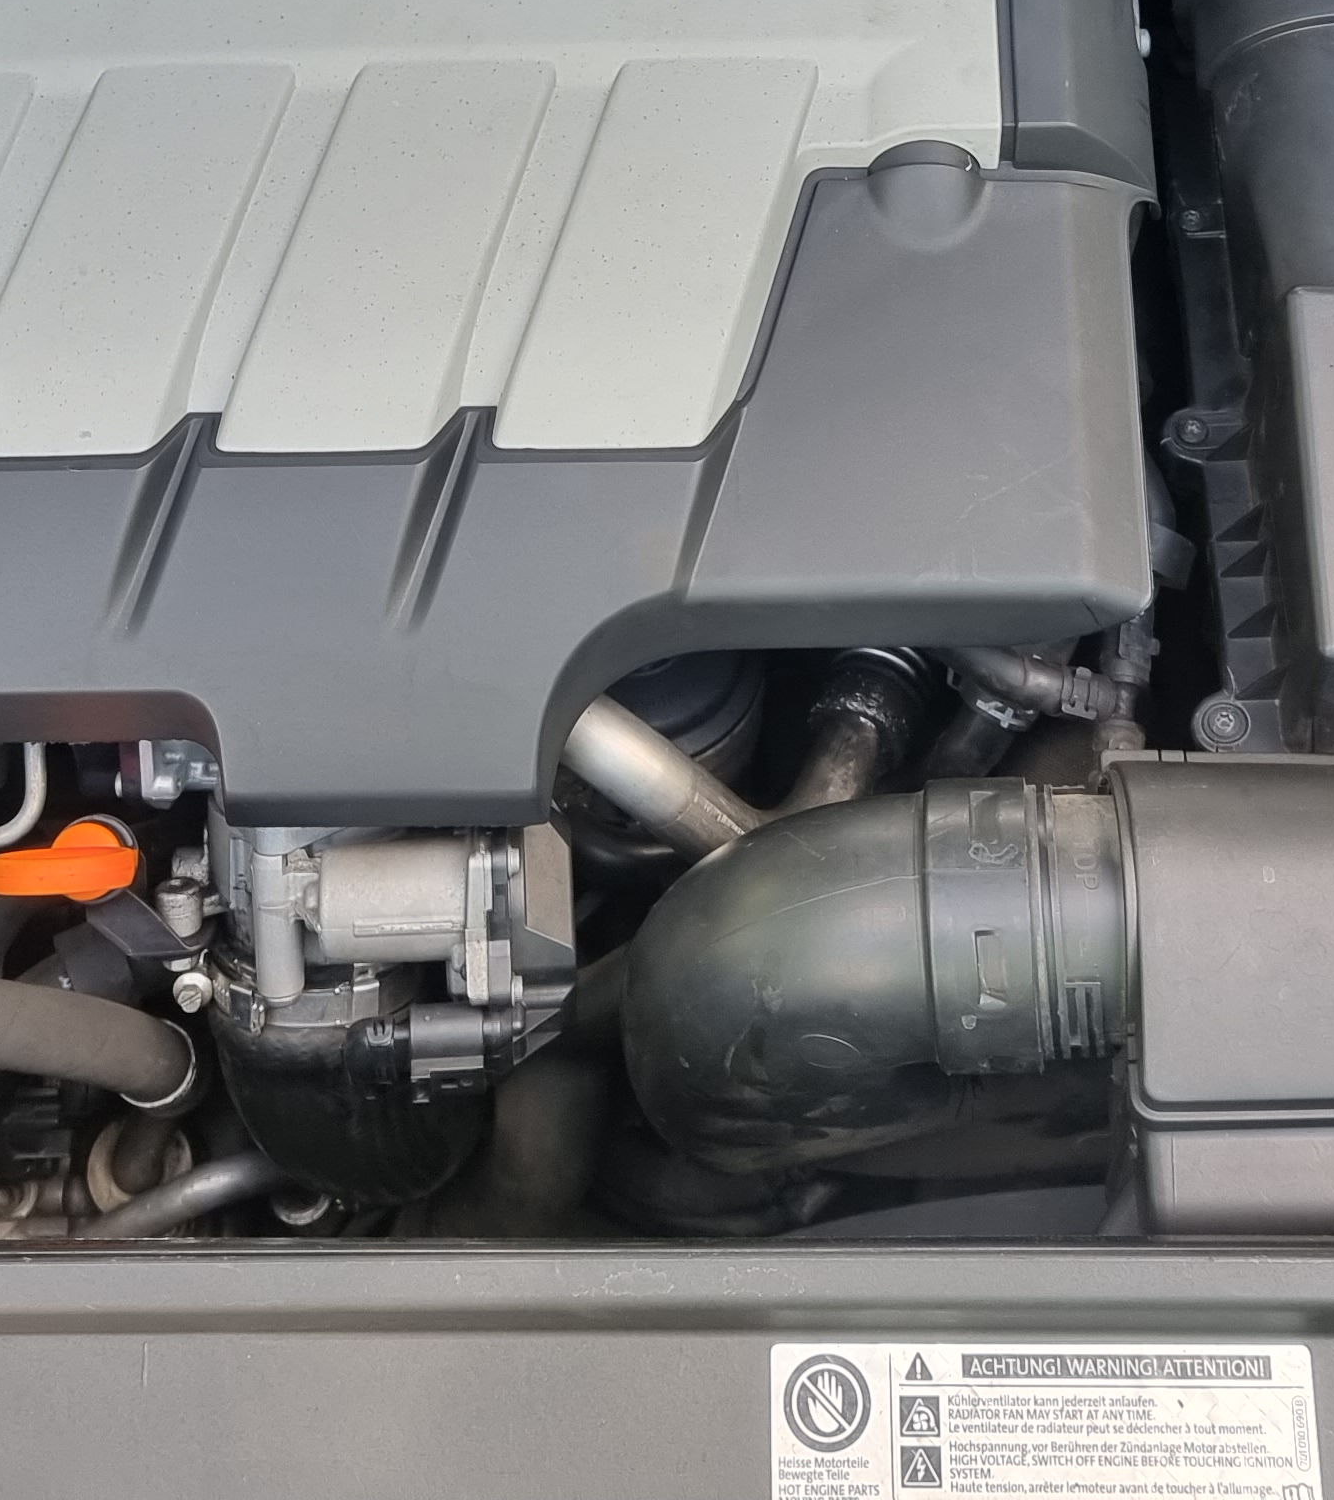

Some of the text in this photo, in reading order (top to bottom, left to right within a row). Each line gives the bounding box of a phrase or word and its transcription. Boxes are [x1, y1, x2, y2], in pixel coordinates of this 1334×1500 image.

[970, 1356, 1265, 1377] ACHTUNG! WARNING! ATTENTION!
[948, 1395, 1158, 1411] Kühlerventilator kann jederzeit anlaufen.
[948, 1409, 1156, 1421] RADIATOR FAN MAY START AT ANY TIME.
[948, 1422, 960, 1434] Le
[962, 1422, 1019, 1434] ventilateur
[1021, 1422, 1034, 1434] de
[1037, 1422, 1084, 1434] radiateur
[1087, 1423, 1110, 1436] peut
[1112, 1425, 1124, 1434] se
[1126, 1422, 1182, 1434] déclencher
[1193, 1424, 1217, 1434] tout
[1218, 1424, 1267, 1435] moment.
[949, 1440, 1270, 1457] Hochspannung, vor Berühren der Zündanlage Motor abstellen.
[779, 1456, 869, 1468] Heisse Motorteile
[949, 1454, 1293, 1468] HIGH VOLTAGE, SWITCH OFF ENGINE BEFORE TOUCHING IGNITION
[779, 1469, 850, 1483] Bewegte Teile
[949, 1468, 995, 1479] SYSTEM.
[779, 1484, 880, 1496] HOT ENGINE PARTS
[951, 1481, 983, 1493] Haute
[985, 1482, 1028, 1494] tension,
[1029, 1482, 1064, 1493] arrêter
[1067, 1482, 1076, 1493] le
[1078, 1483, 1117, 1493] moteur
[1119, 1483, 1149, 1494] avant
[1151, 1482, 1164, 1494] de
[1166, 1482, 1206, 1494] toucher
[1209, 1482, 1215, 1494] à
